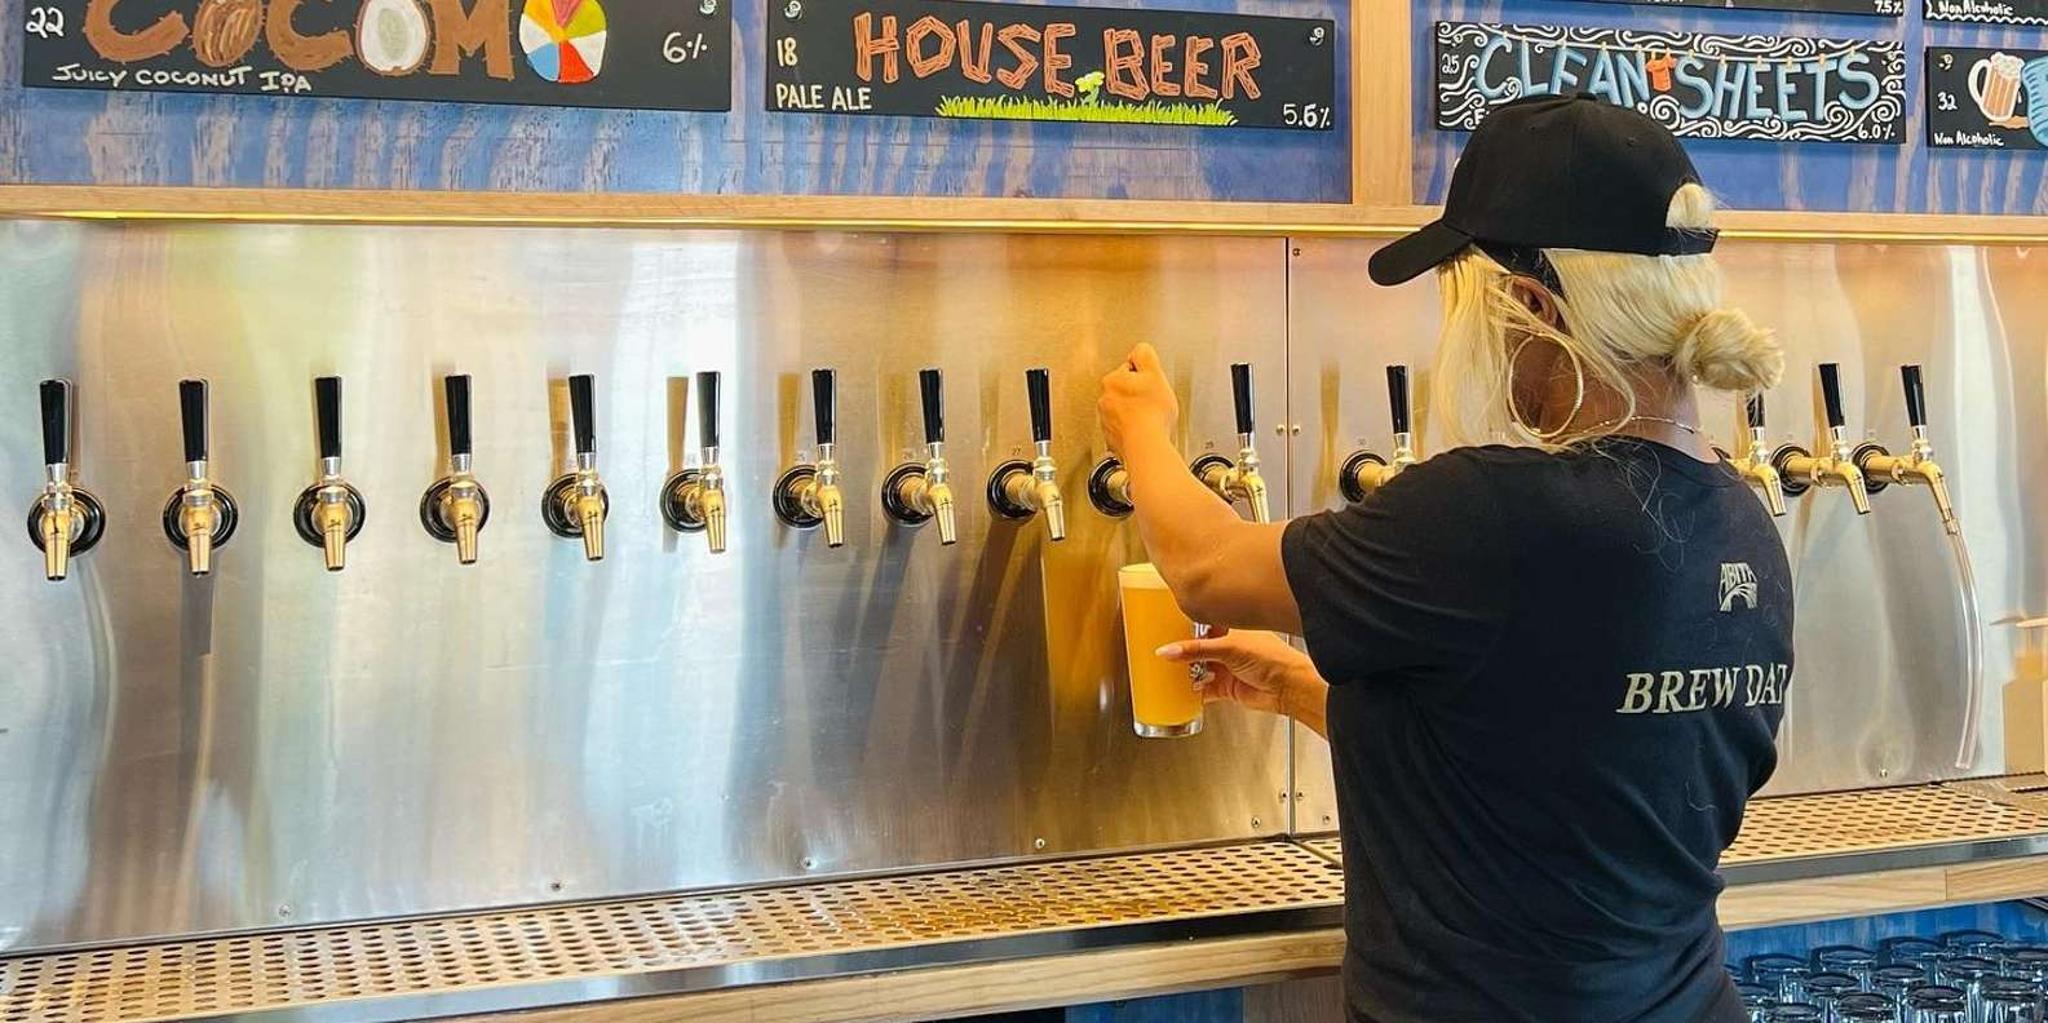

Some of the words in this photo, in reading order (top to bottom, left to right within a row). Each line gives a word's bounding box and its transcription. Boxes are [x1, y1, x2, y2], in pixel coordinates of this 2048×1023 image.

[26, 7, 64, 38] 22
[661, 32, 708, 64] 6%
[776, 37, 798, 67] 18
[853, 12, 1076, 98] HOUSE
[1103, 28, 1262, 101] BEER
[1441, 52, 1460, 74] 25
[52, 63, 126, 87] JUICY
[135, 65, 252, 87] COCONUT
[259, 70, 312, 93] IPA
[1475, 35, 1651, 109] CLEAN
[1674, 51, 1880, 122] SHEETS
[776, 83, 824, 109] PALE
[831, 86, 872, 112] ALE
[1937, 91, 1958, 111] 32
[1283, 103, 1331, 128] 5.6%
[1857, 125, 1895, 140] 6.0%
[1934, 132, 1954, 146] Non
[1956, 130, 2004, 147] Alcoholic
[1615, 666, 1742, 714] BREW
